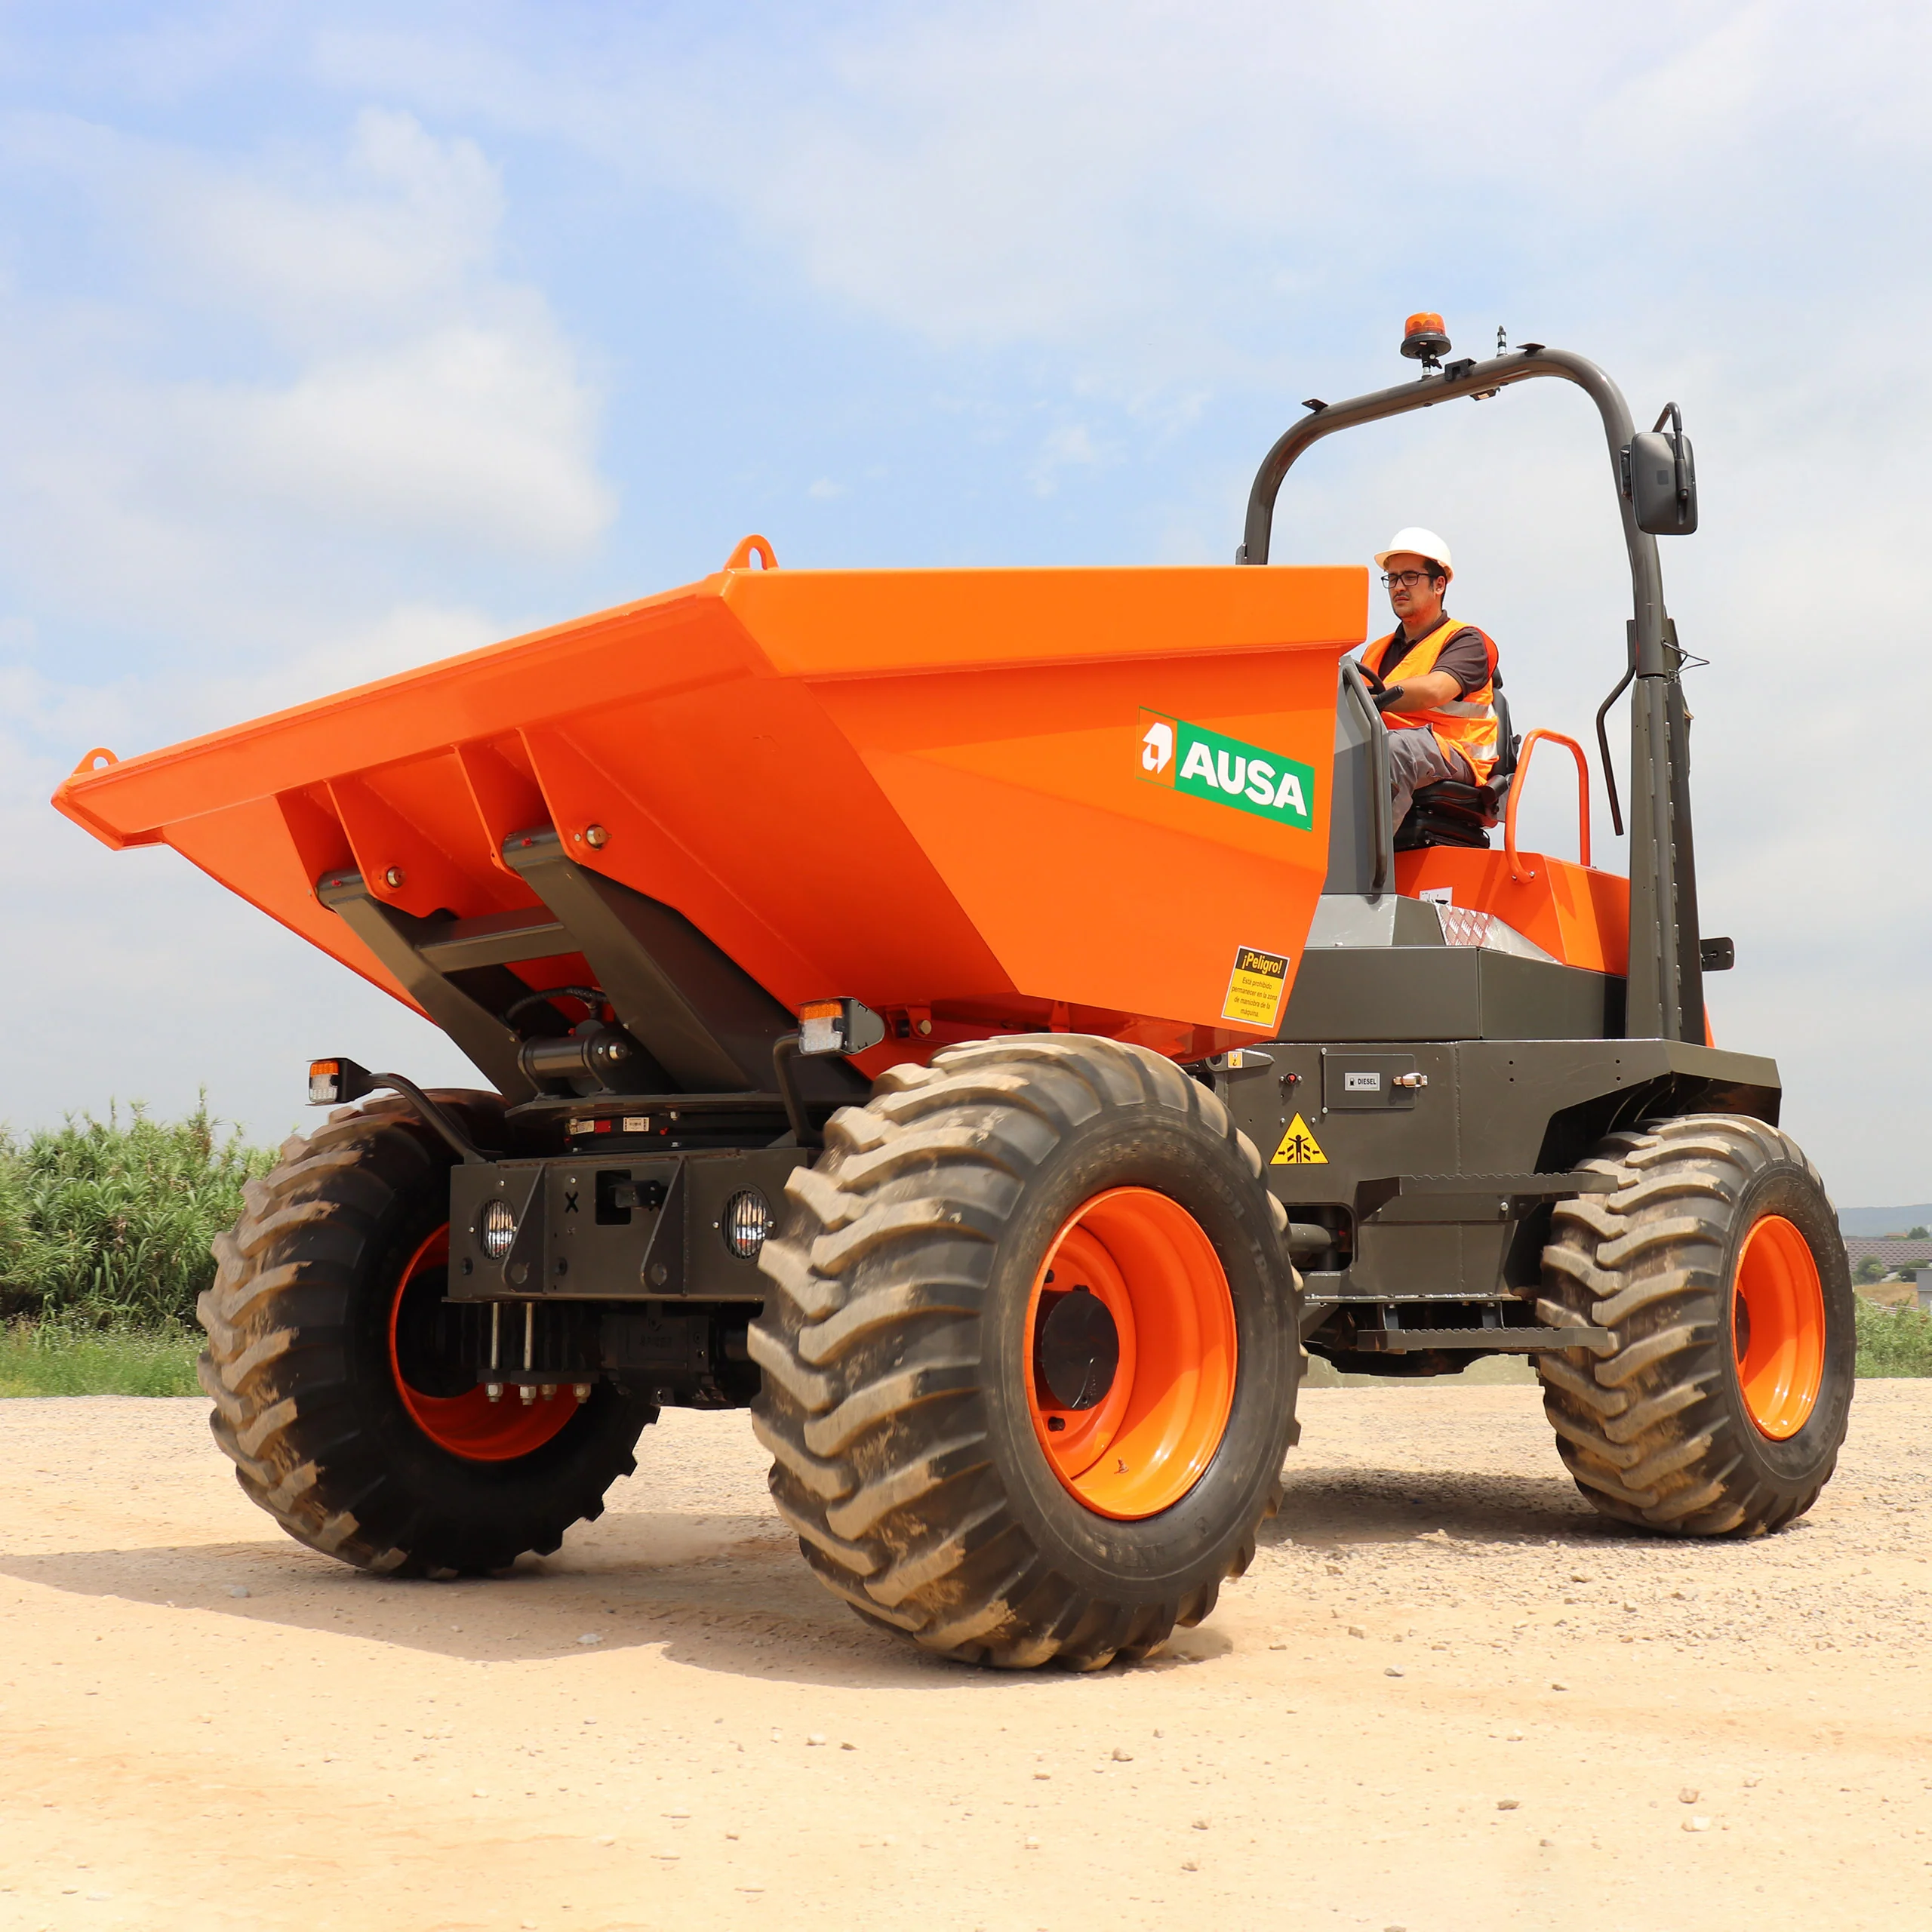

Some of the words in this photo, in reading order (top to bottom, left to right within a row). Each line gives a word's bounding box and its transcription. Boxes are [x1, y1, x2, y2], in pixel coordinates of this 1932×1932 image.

[1180, 741, 1307, 817] AUSA
[1241, 952, 1283, 974] ¡Peligro!
[1252, 980, 1272, 989] prohibido
[1231, 986, 1257, 996] permanecer
[1240, 998, 1260, 1008] maniobra
